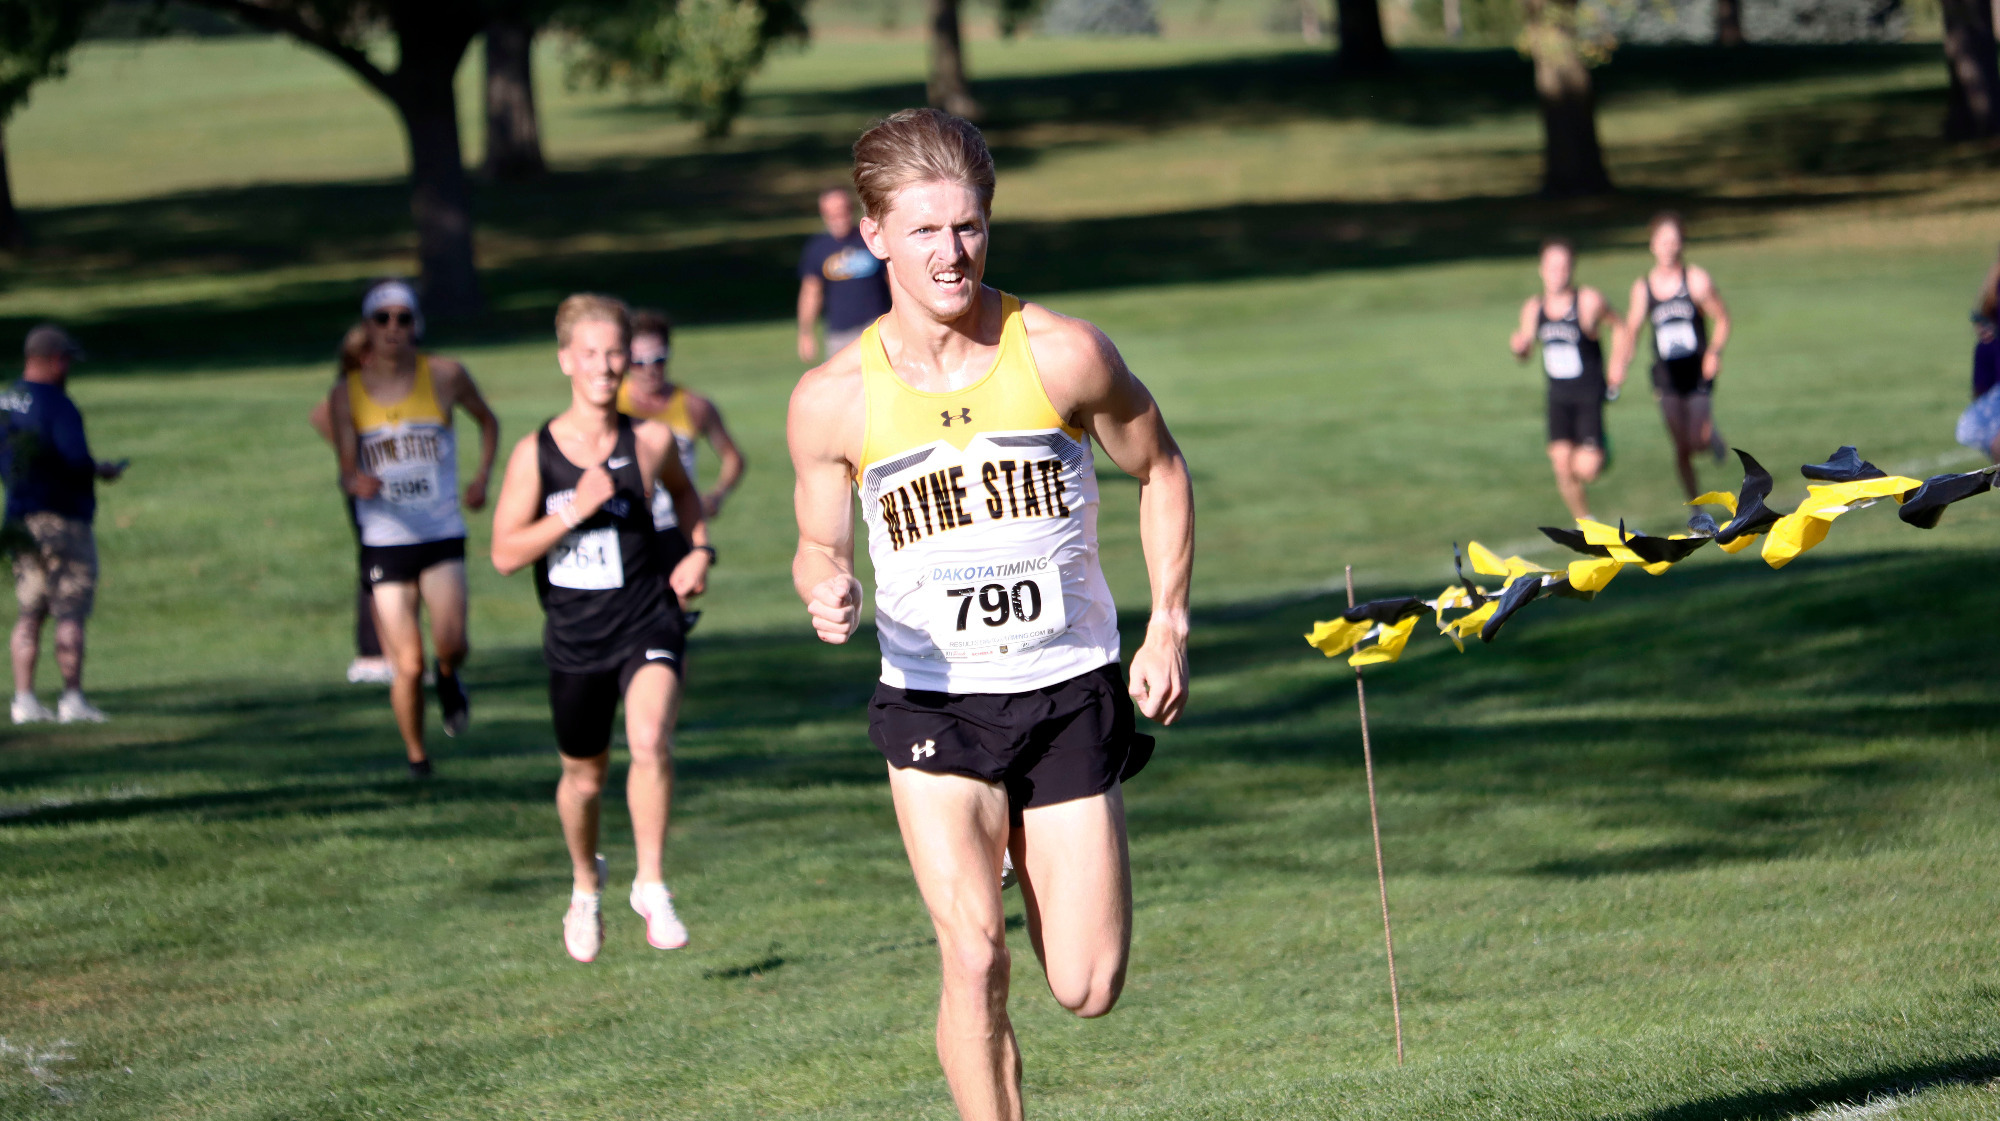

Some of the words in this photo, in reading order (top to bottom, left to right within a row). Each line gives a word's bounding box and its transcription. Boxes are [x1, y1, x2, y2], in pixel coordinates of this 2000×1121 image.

[879, 465, 973, 551] WAYNE
[982, 460, 1070, 519] STATE
[555, 545, 607, 569] 264
[932, 556, 1049, 582] DAKOTATIMING
[946, 579, 1042, 632] 790
